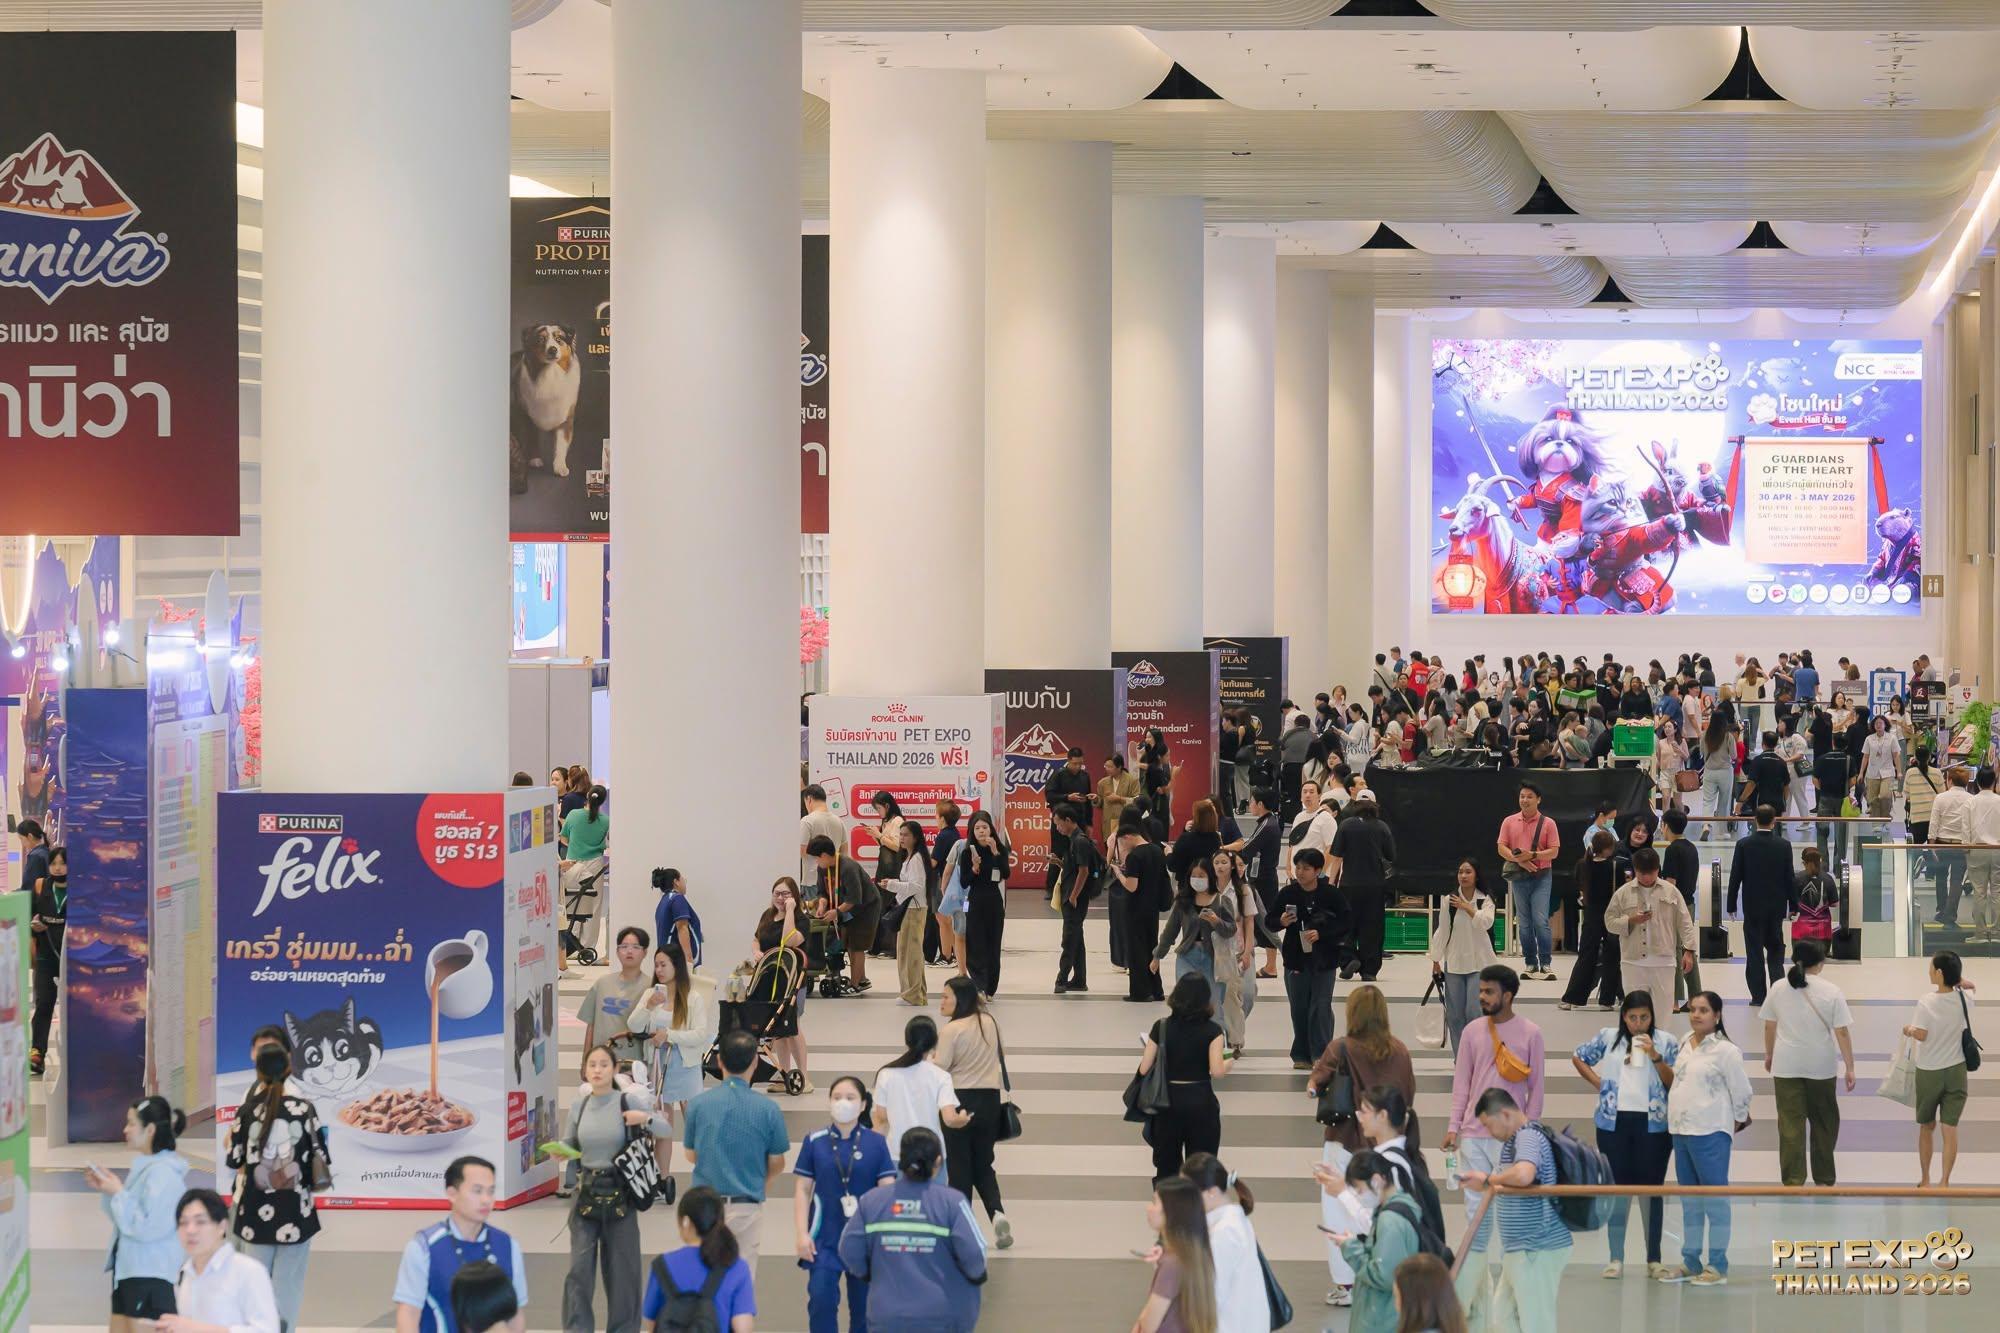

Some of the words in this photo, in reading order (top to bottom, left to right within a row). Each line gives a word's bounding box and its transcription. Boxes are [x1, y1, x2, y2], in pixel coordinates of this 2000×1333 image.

[536, 245, 583, 260] PRO
[69, 323, 109, 343] และ
[119, 316, 170, 350] สุนัข
[1844, 364, 1875, 375] NCC
[1565, 365, 1621, 389] PET
[1566, 391, 1669, 410] THAILAND
[1671, 393, 1729, 411] 2026
[1779, 393, 1844, 412] โซนใหม่
[1778, 415, 1802, 424] Event
[1804, 415, 1820, 424] Hall
[1834, 415, 1847, 424] B2
[1771, 455, 1845, 464] GUARDIANS
[1762, 465, 1779, 474] OF
[1783, 466, 1808, 474] THE
[1812, 466, 1854, 475] HEART
[1759, 493, 1770, 501] 30
[1773, 493, 1792, 501] APR
[1221, 656, 1248, 664] PLAN
[1127, 675, 1163, 689] Kaniva
[1006, 685, 1071, 709] พบกับ
[871, 715, 897, 723] ROYAL
[898, 715, 923, 723] CANIN
[904, 729, 930, 742] PET
[935, 729, 971, 742] EXPO
[827, 752, 898, 765] THAILAND
[902, 752, 935, 765] 2026
[279, 818, 338, 829] PURINA
[434, 821, 486, 840] ฮอลล์
[487, 825, 499, 840] 7
[435, 845, 459, 864] บูธ
[463, 843, 498, 859] S13
[252, 836, 381, 917] felix
[225, 926, 283, 960] เกรวี่
[250, 966, 386, 988] อร่อยจนหยดสุดท้าย
